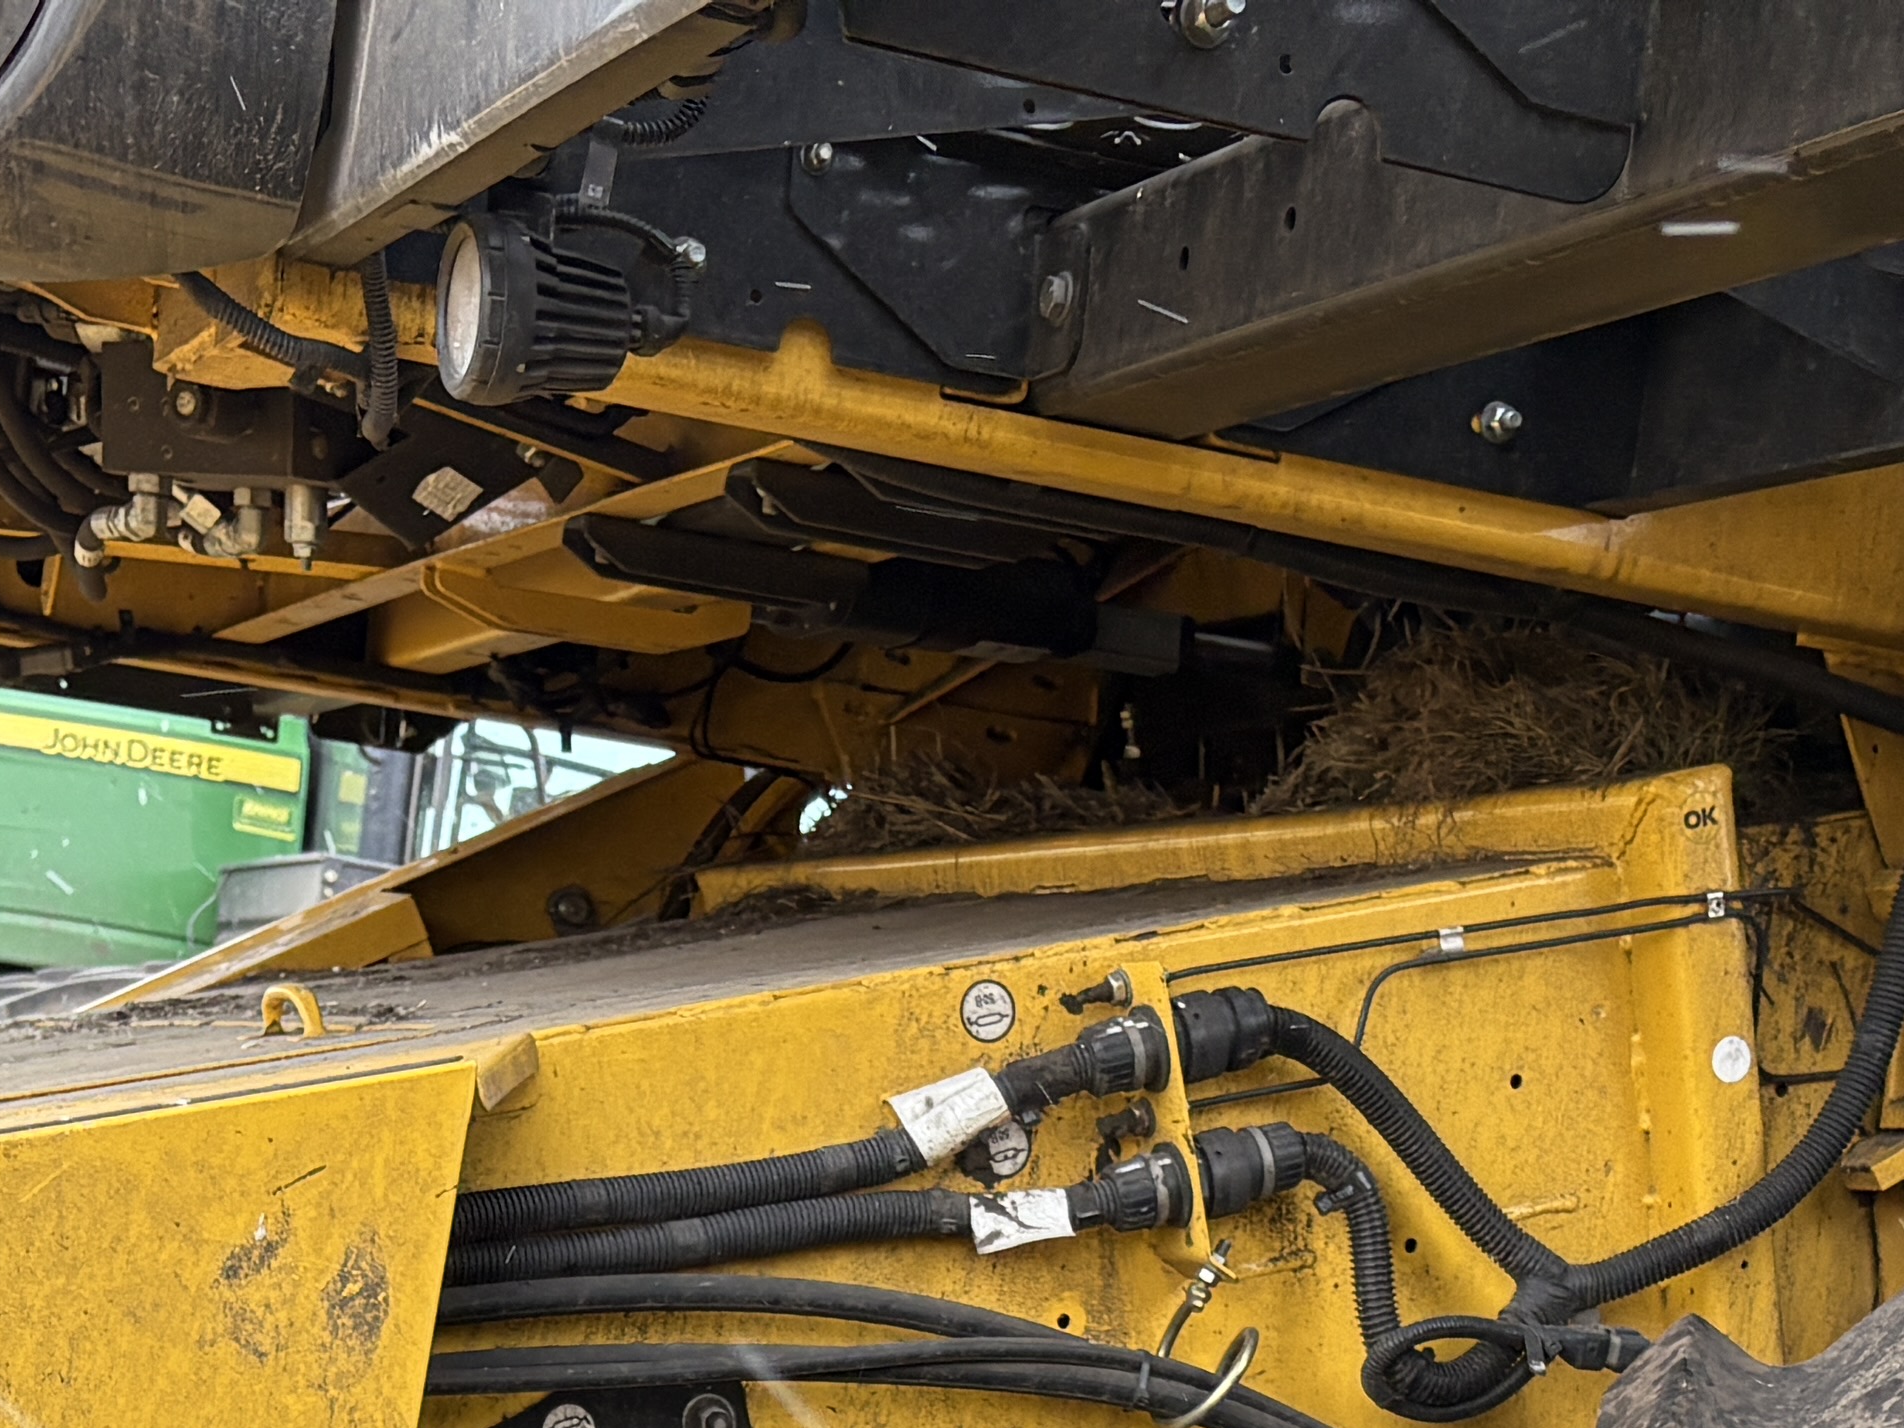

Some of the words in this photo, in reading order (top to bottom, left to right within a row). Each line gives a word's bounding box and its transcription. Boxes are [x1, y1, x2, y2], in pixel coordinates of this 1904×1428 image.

[43, 728, 120, 759] JOHN
[127, 739, 223, 776] DEERE
[1683, 805, 1718, 829] OK
